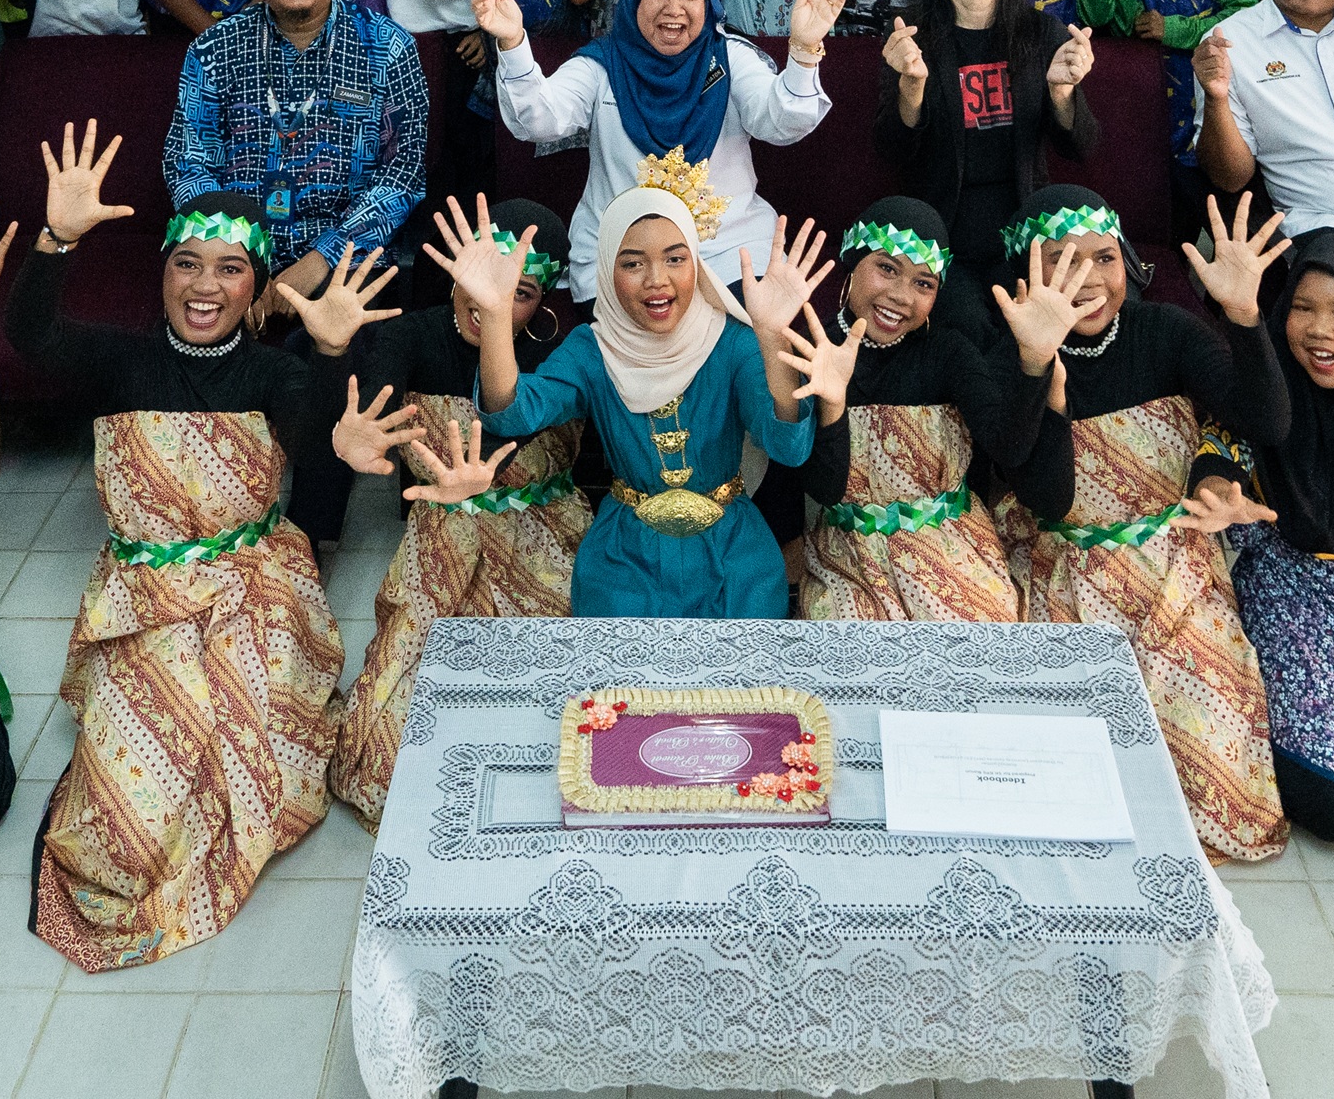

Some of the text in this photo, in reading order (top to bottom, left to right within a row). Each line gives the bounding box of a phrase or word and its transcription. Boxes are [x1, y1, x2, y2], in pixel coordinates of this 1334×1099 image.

[654, 736, 738, 750] Visitor's Book
[650, 754, 740, 768] Buku Pelawat
[976, 775, 1026, 784] Ideabook
